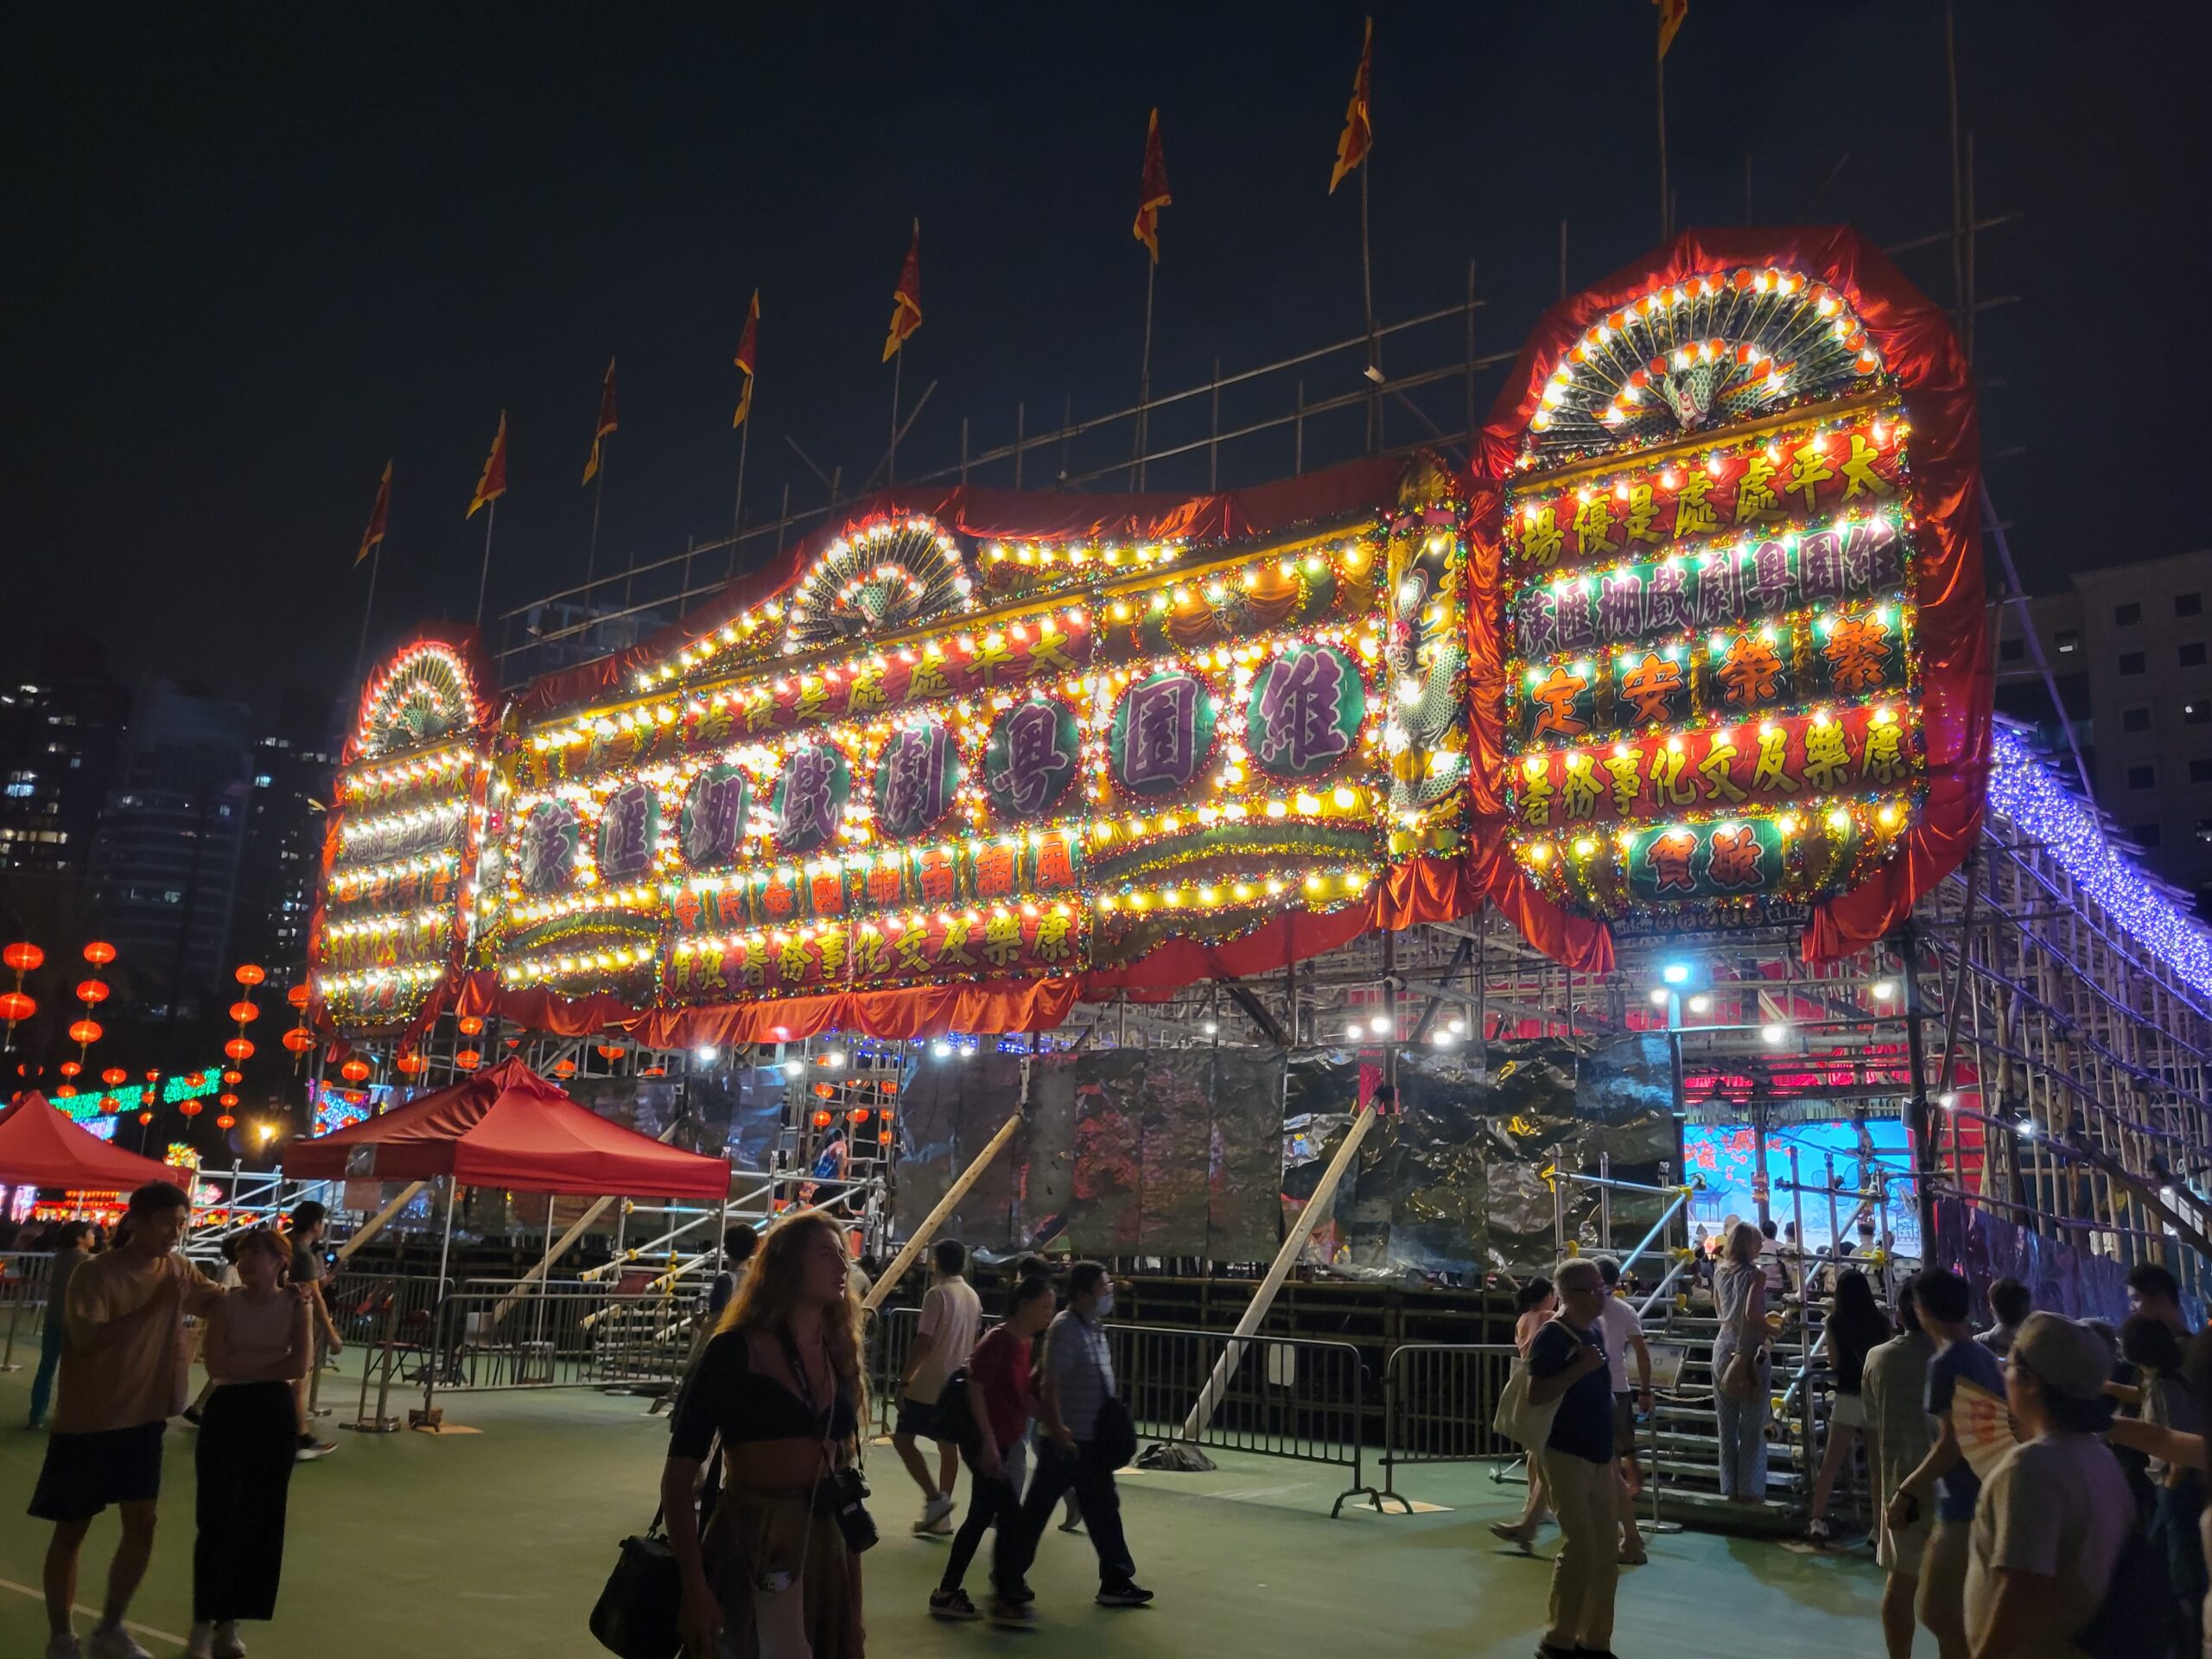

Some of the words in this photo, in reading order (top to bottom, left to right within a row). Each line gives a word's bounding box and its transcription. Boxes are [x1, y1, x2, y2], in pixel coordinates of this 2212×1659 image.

[1521, 434, 1898, 567] 太平處處是優場
[1530, 610, 1894, 741] 繁榮安定
[1519, 710, 1908, 828] 康樂及文化事務署
[673, 831, 1079, 931] 風調雨順國泰民安
[1646, 823, 1765, 892] 敬賀
[741, 909, 1073, 987] 康樂及文化事務署
